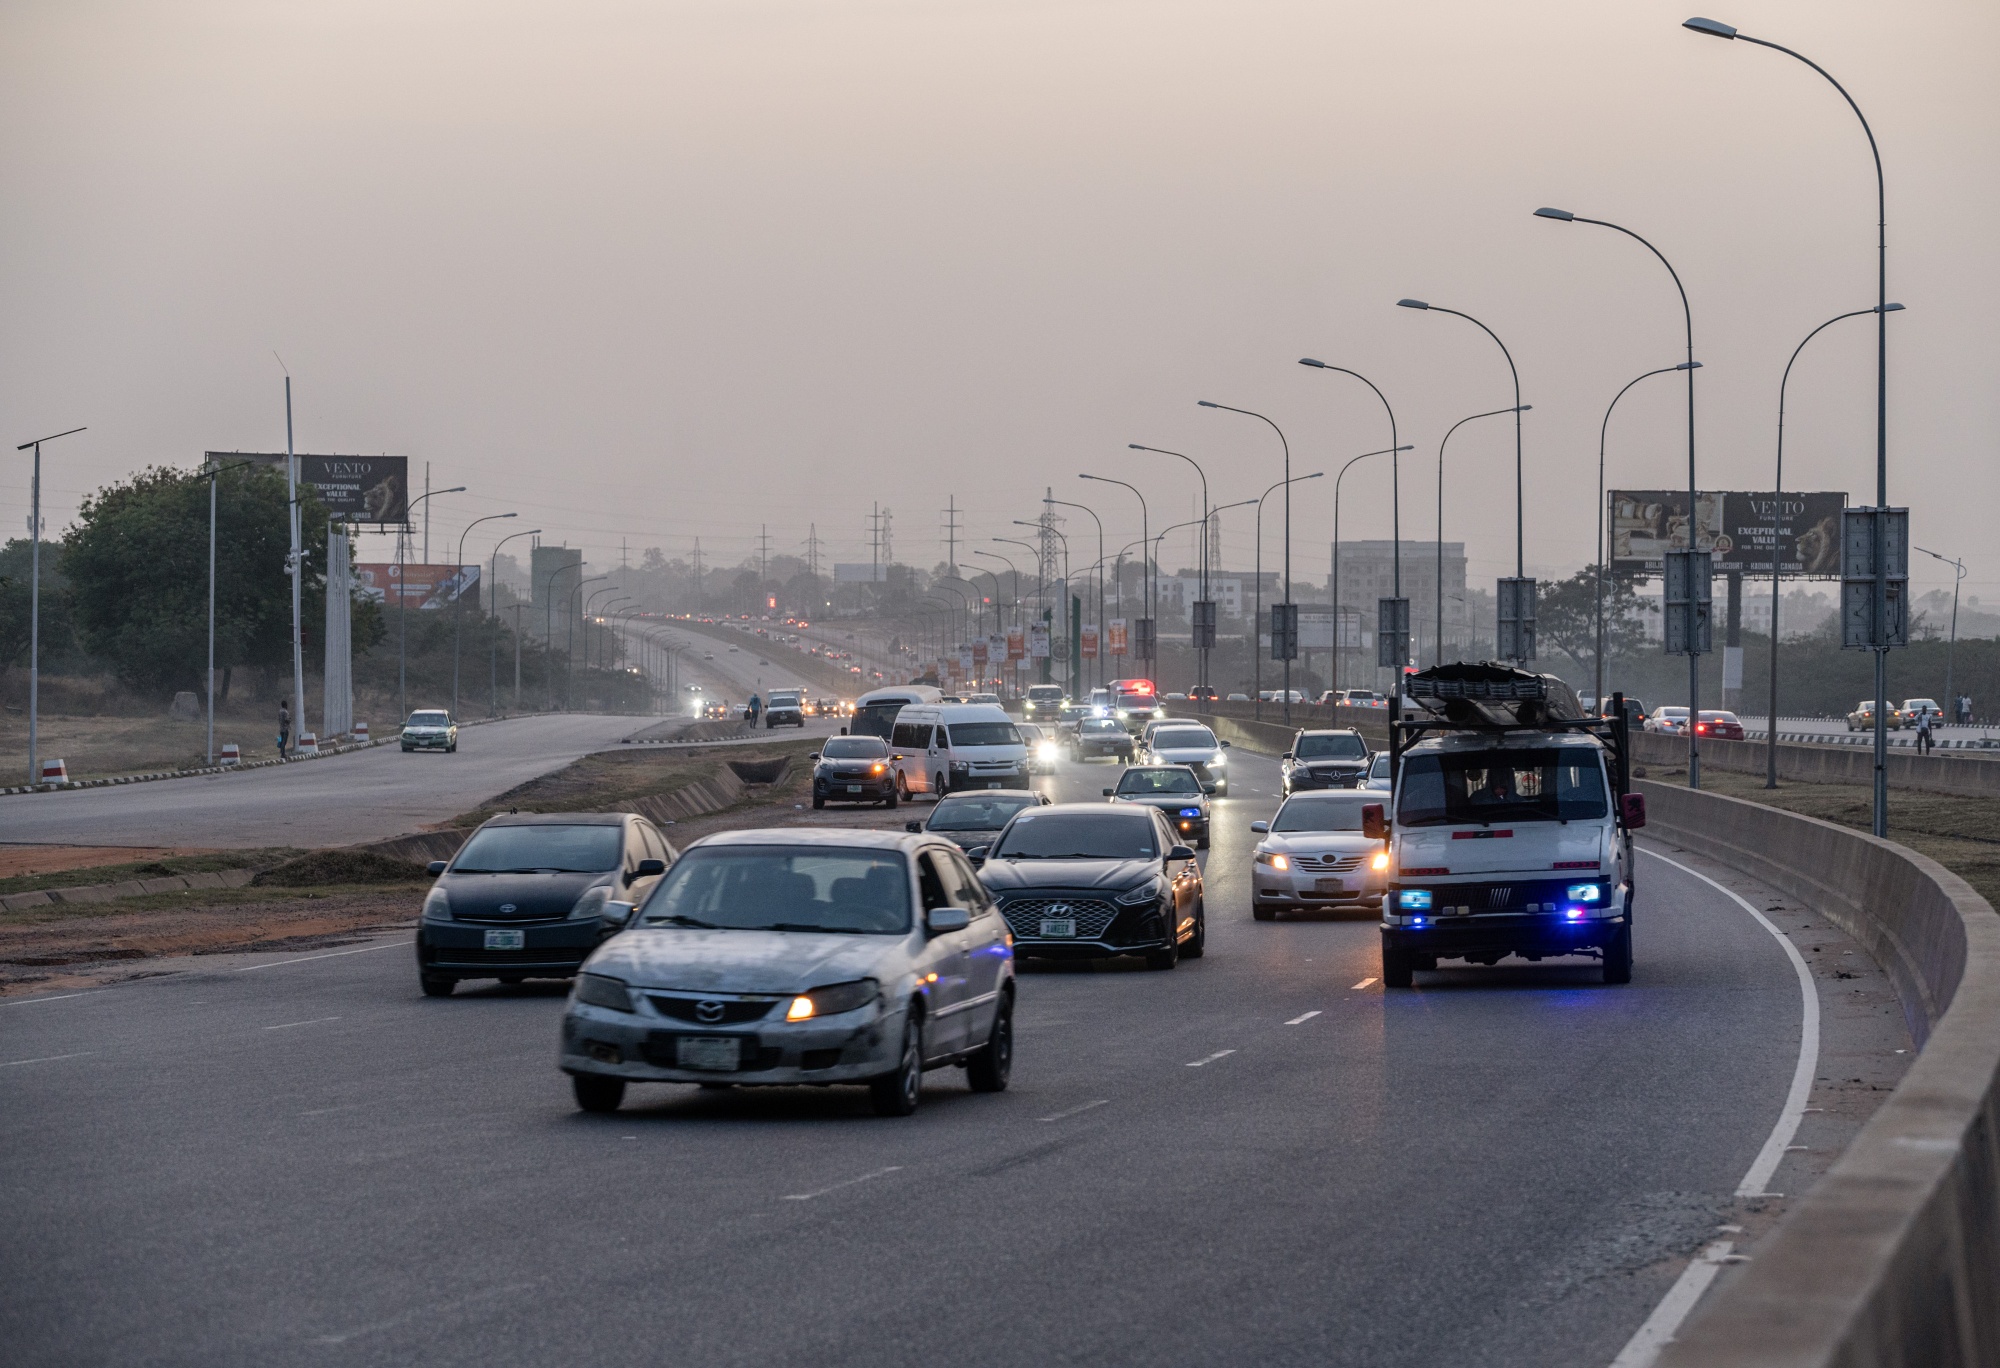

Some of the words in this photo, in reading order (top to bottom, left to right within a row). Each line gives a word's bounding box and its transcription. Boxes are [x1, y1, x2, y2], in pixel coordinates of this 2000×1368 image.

[324, 462, 371, 473] VENTO
[1644, 561, 1663, 569] ABUJA
[1750, 562, 1773, 570] KADUNA
[1780, 562, 1803, 570] CANADA
